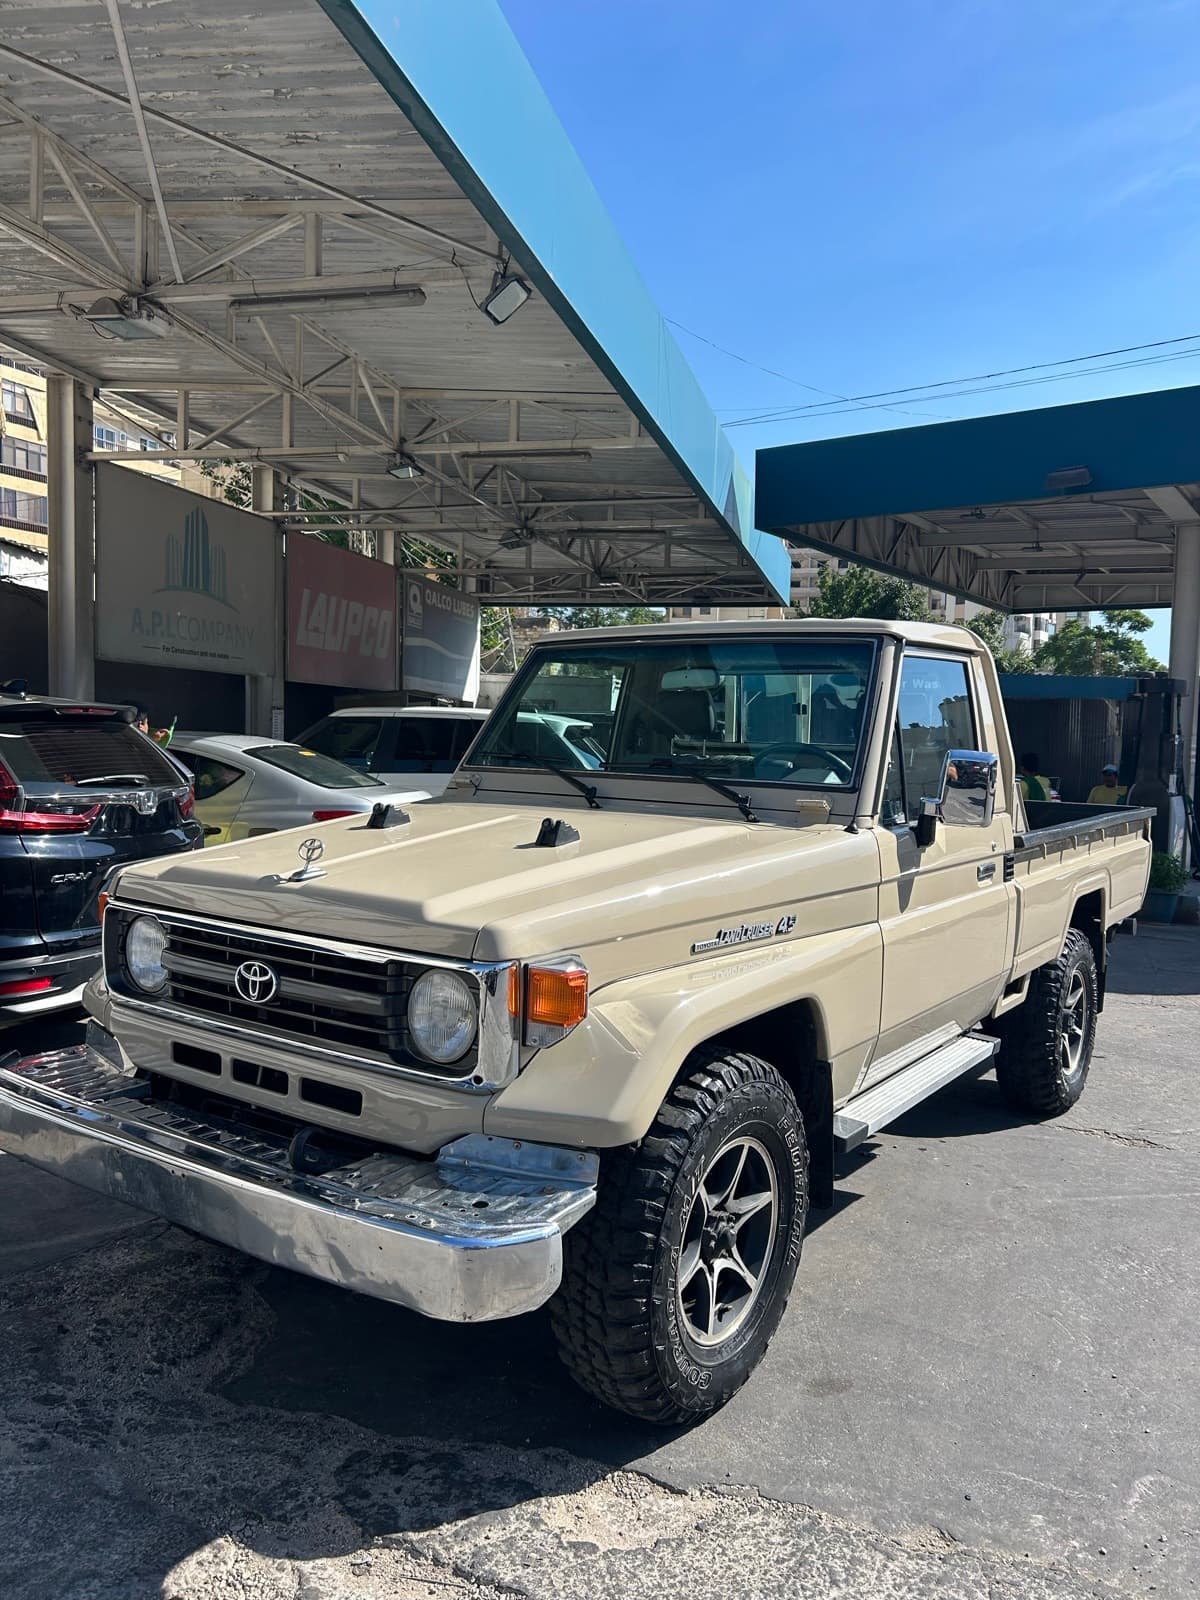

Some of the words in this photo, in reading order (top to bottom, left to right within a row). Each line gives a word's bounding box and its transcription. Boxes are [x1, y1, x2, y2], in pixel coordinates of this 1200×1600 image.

[425, 589, 452, 610] QALCO
[776, 1115, 805, 1267] FEDERAL
[665, 1245, 713, 1390] COURAGIA
